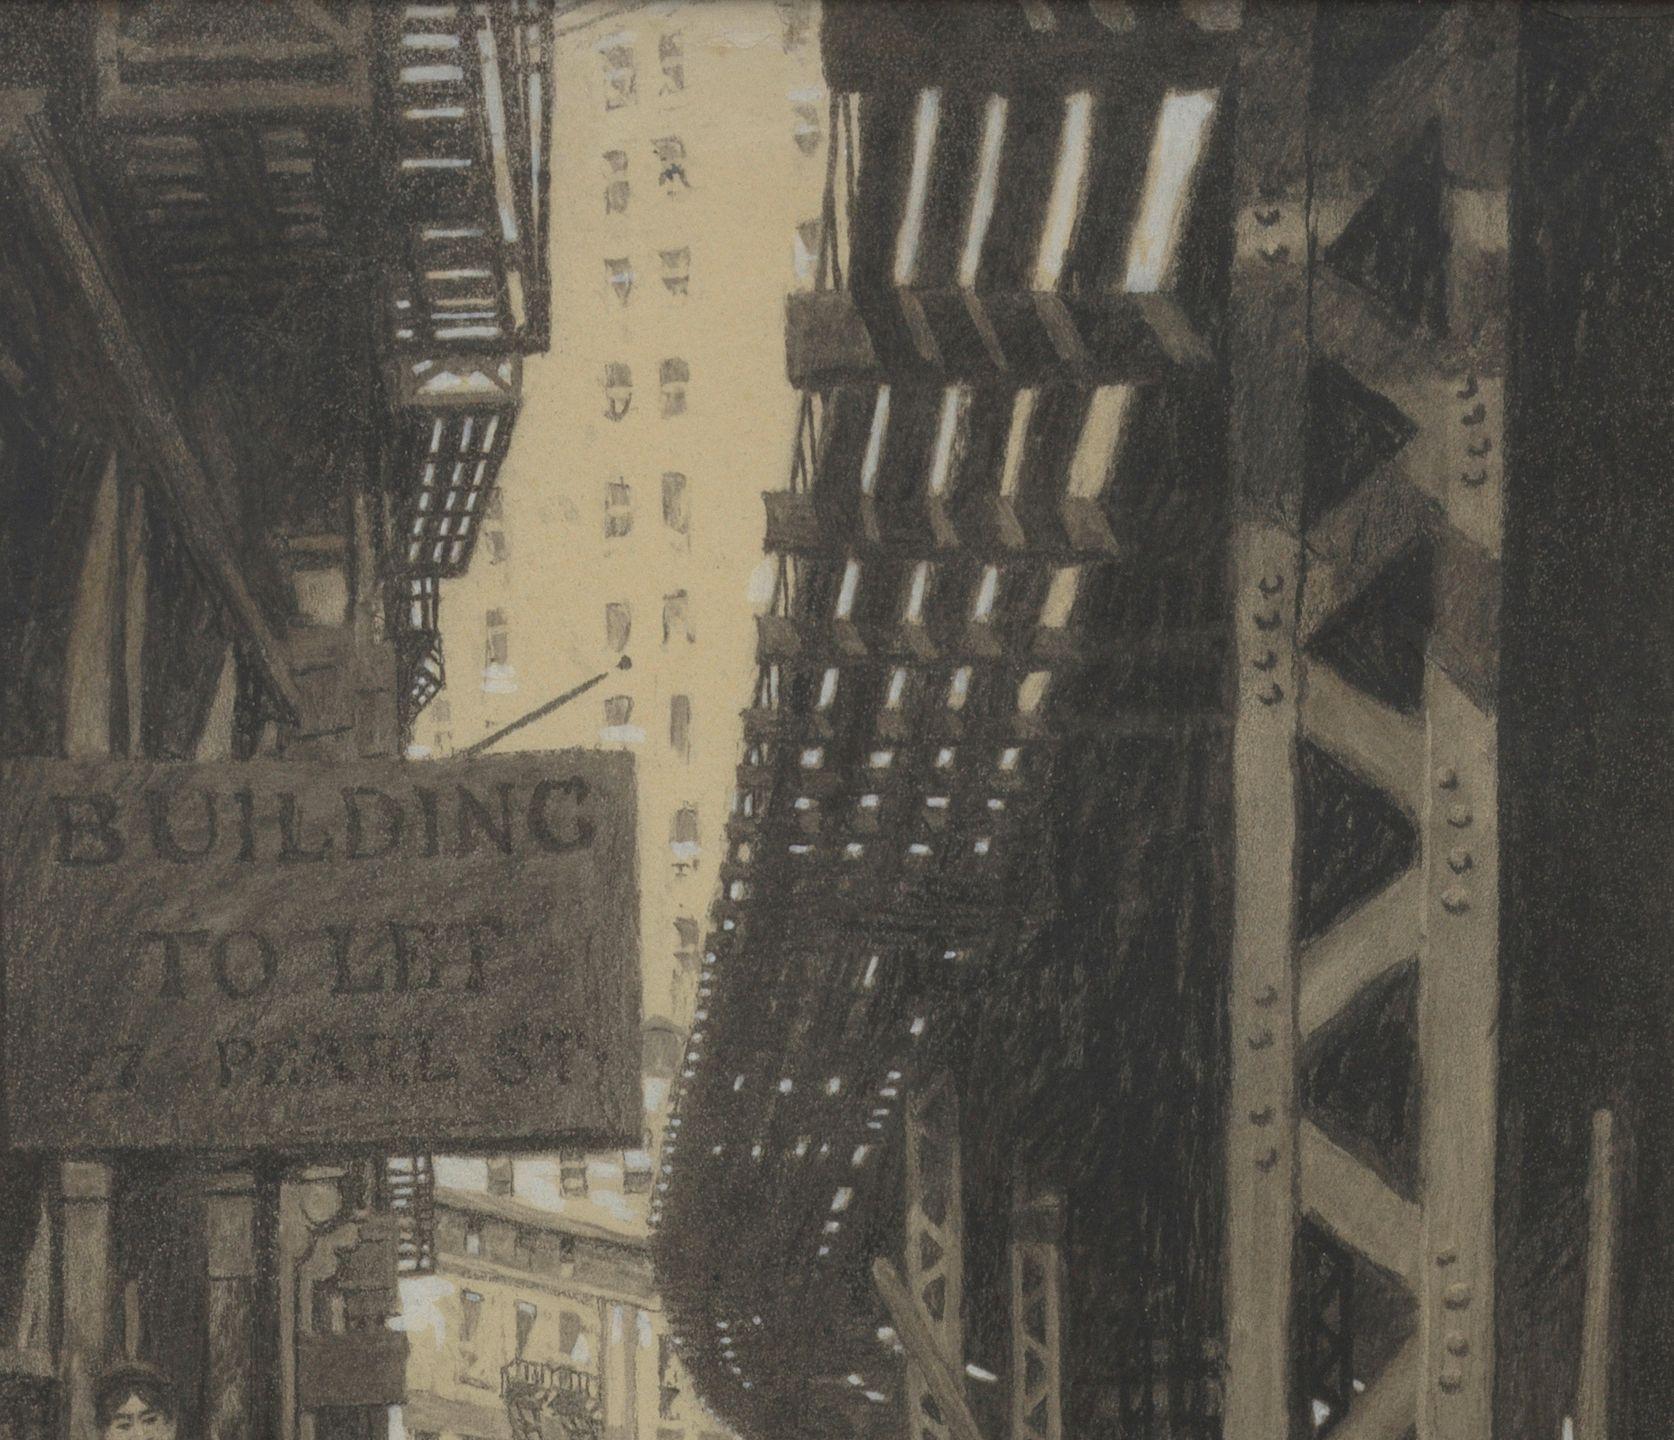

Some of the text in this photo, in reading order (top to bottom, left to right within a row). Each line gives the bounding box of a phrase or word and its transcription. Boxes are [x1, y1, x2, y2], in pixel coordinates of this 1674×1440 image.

[53, 775, 597, 866] BUILDING
[139, 915, 504, 1000] TO LET
